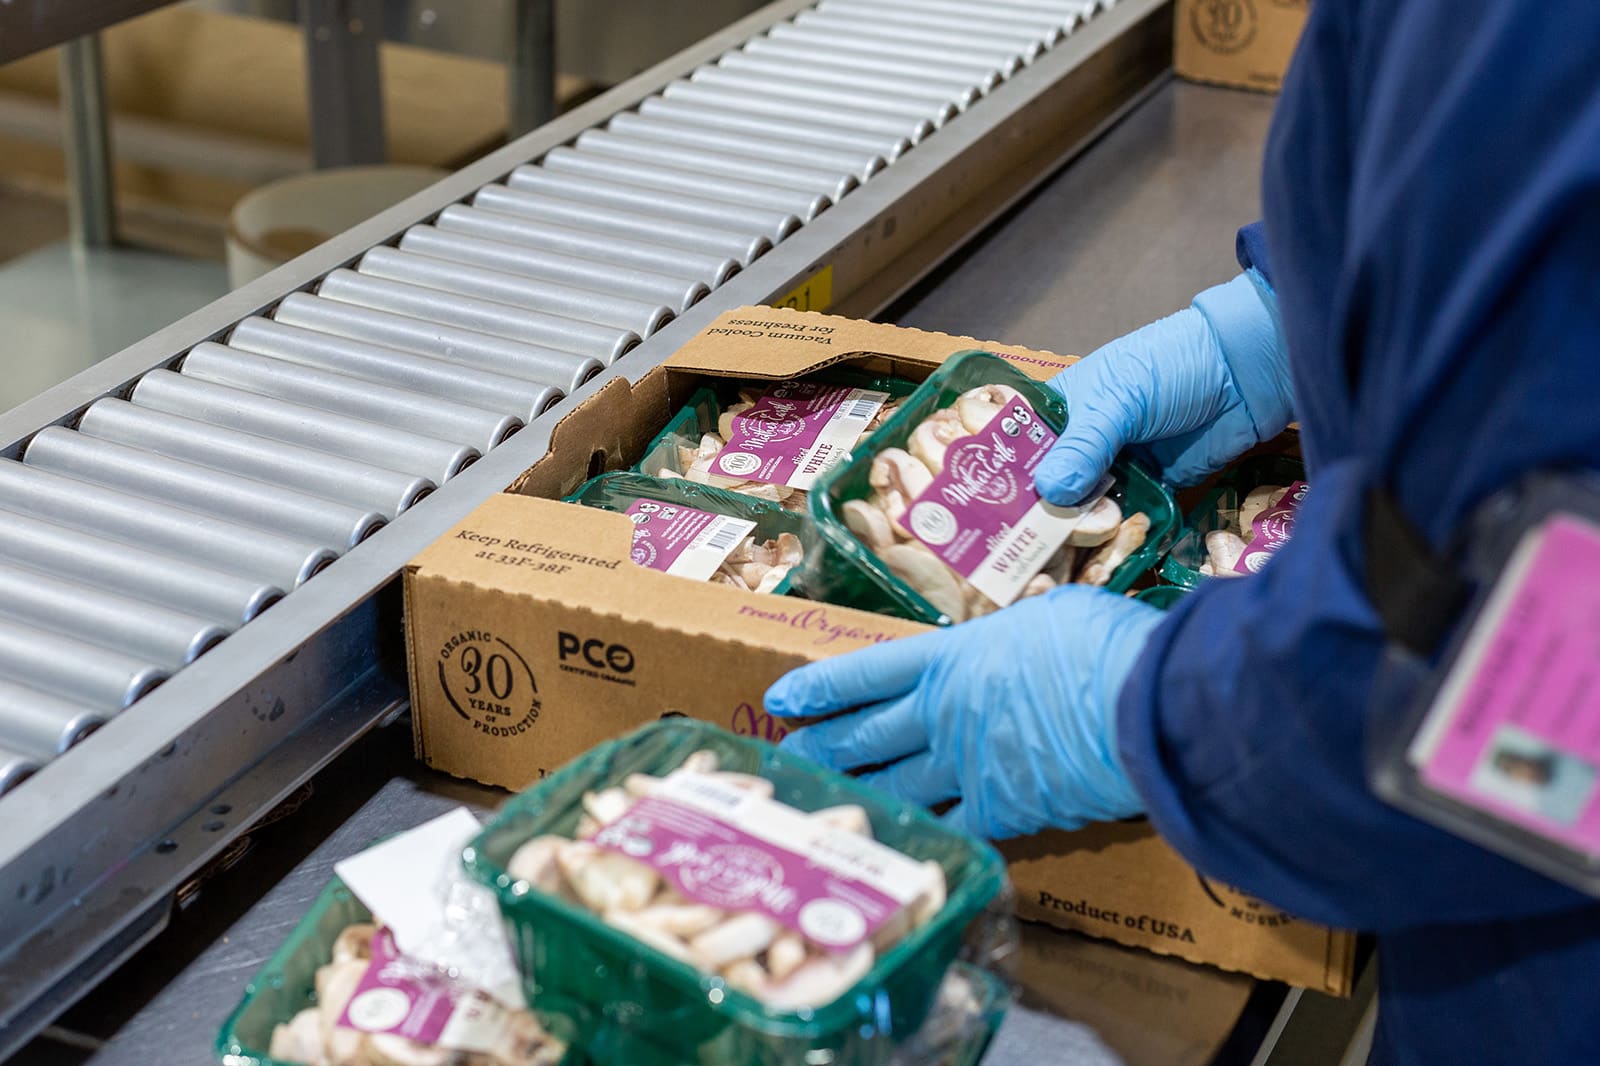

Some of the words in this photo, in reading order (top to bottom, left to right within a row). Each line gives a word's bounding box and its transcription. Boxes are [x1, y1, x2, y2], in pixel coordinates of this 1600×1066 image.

[707, 328, 764, 338] Cooled
[728, 319, 808, 332] Freshness
[767, 332, 832, 345] Vacuum
[809, 326, 836, 335] for
[802, 443, 833, 474] WHITE
[941, 461, 992, 506] Mother
[975, 432, 1017, 474] Earth
[454, 530, 501, 546] Keep
[503, 539, 622, 570] Refrigerated
[475, 550, 496, 560] at
[494, 554, 572, 575] 33F-38F
[991, 527, 1038, 573] WHITE
[441, 630, 491, 659] ORGANIC
[558, 631, 635, 674] PCO
[461, 646, 513, 700] 30
[469, 698, 512, 716] YEARS
[473, 698, 542, 737] PRODUCTION
[485, 714, 496, 723] OF
[1038, 891, 1120, 925] Product
[1124, 914, 1149, 931] of
[1151, 918, 1196, 943] USA
